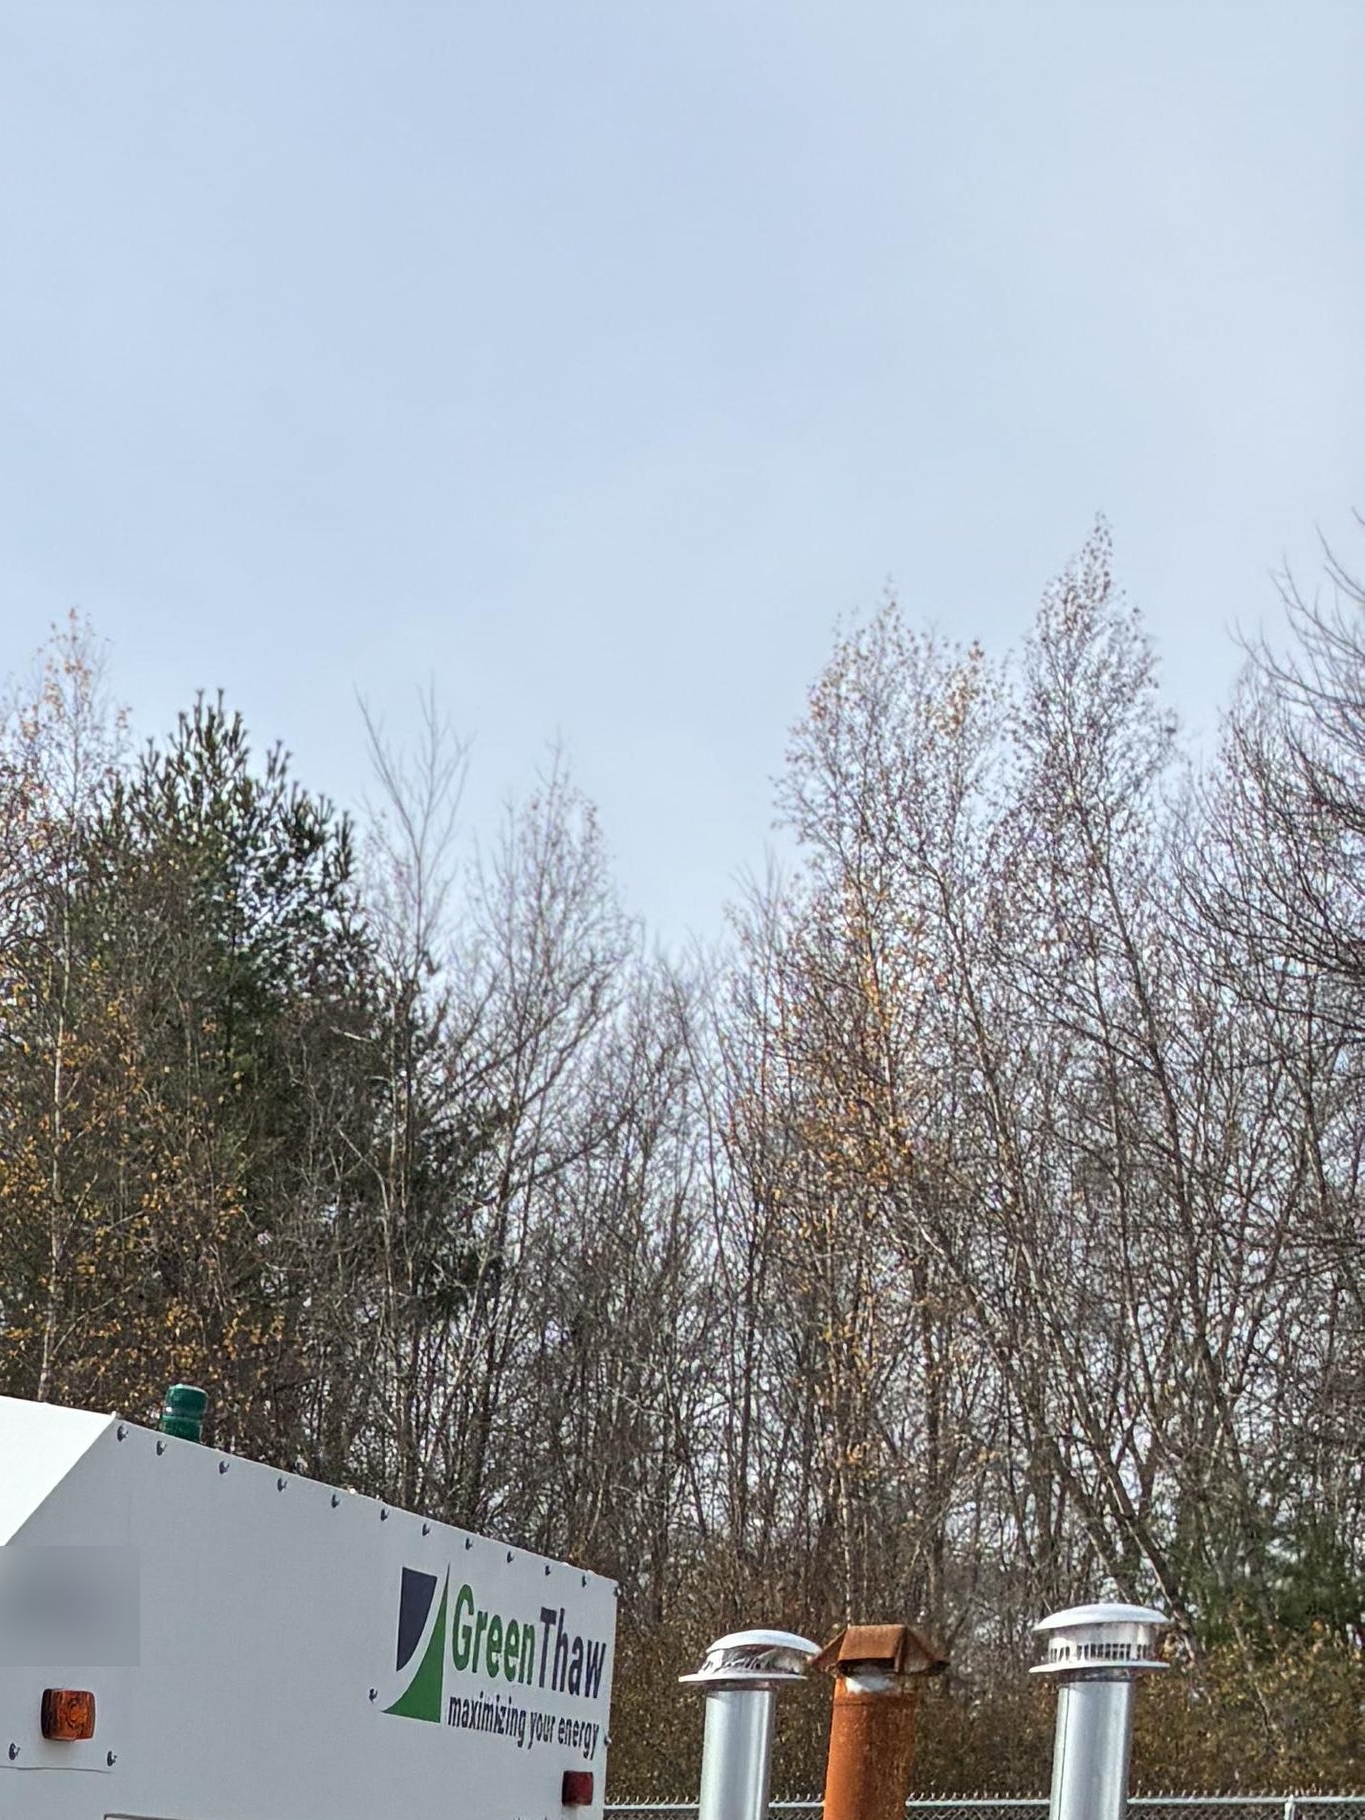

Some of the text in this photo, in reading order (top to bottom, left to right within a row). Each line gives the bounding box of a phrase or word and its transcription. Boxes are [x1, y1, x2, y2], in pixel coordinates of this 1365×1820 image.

[452, 1583, 607, 1699] GreenThaw
[447, 1691, 599, 1760] maximizing your energy
